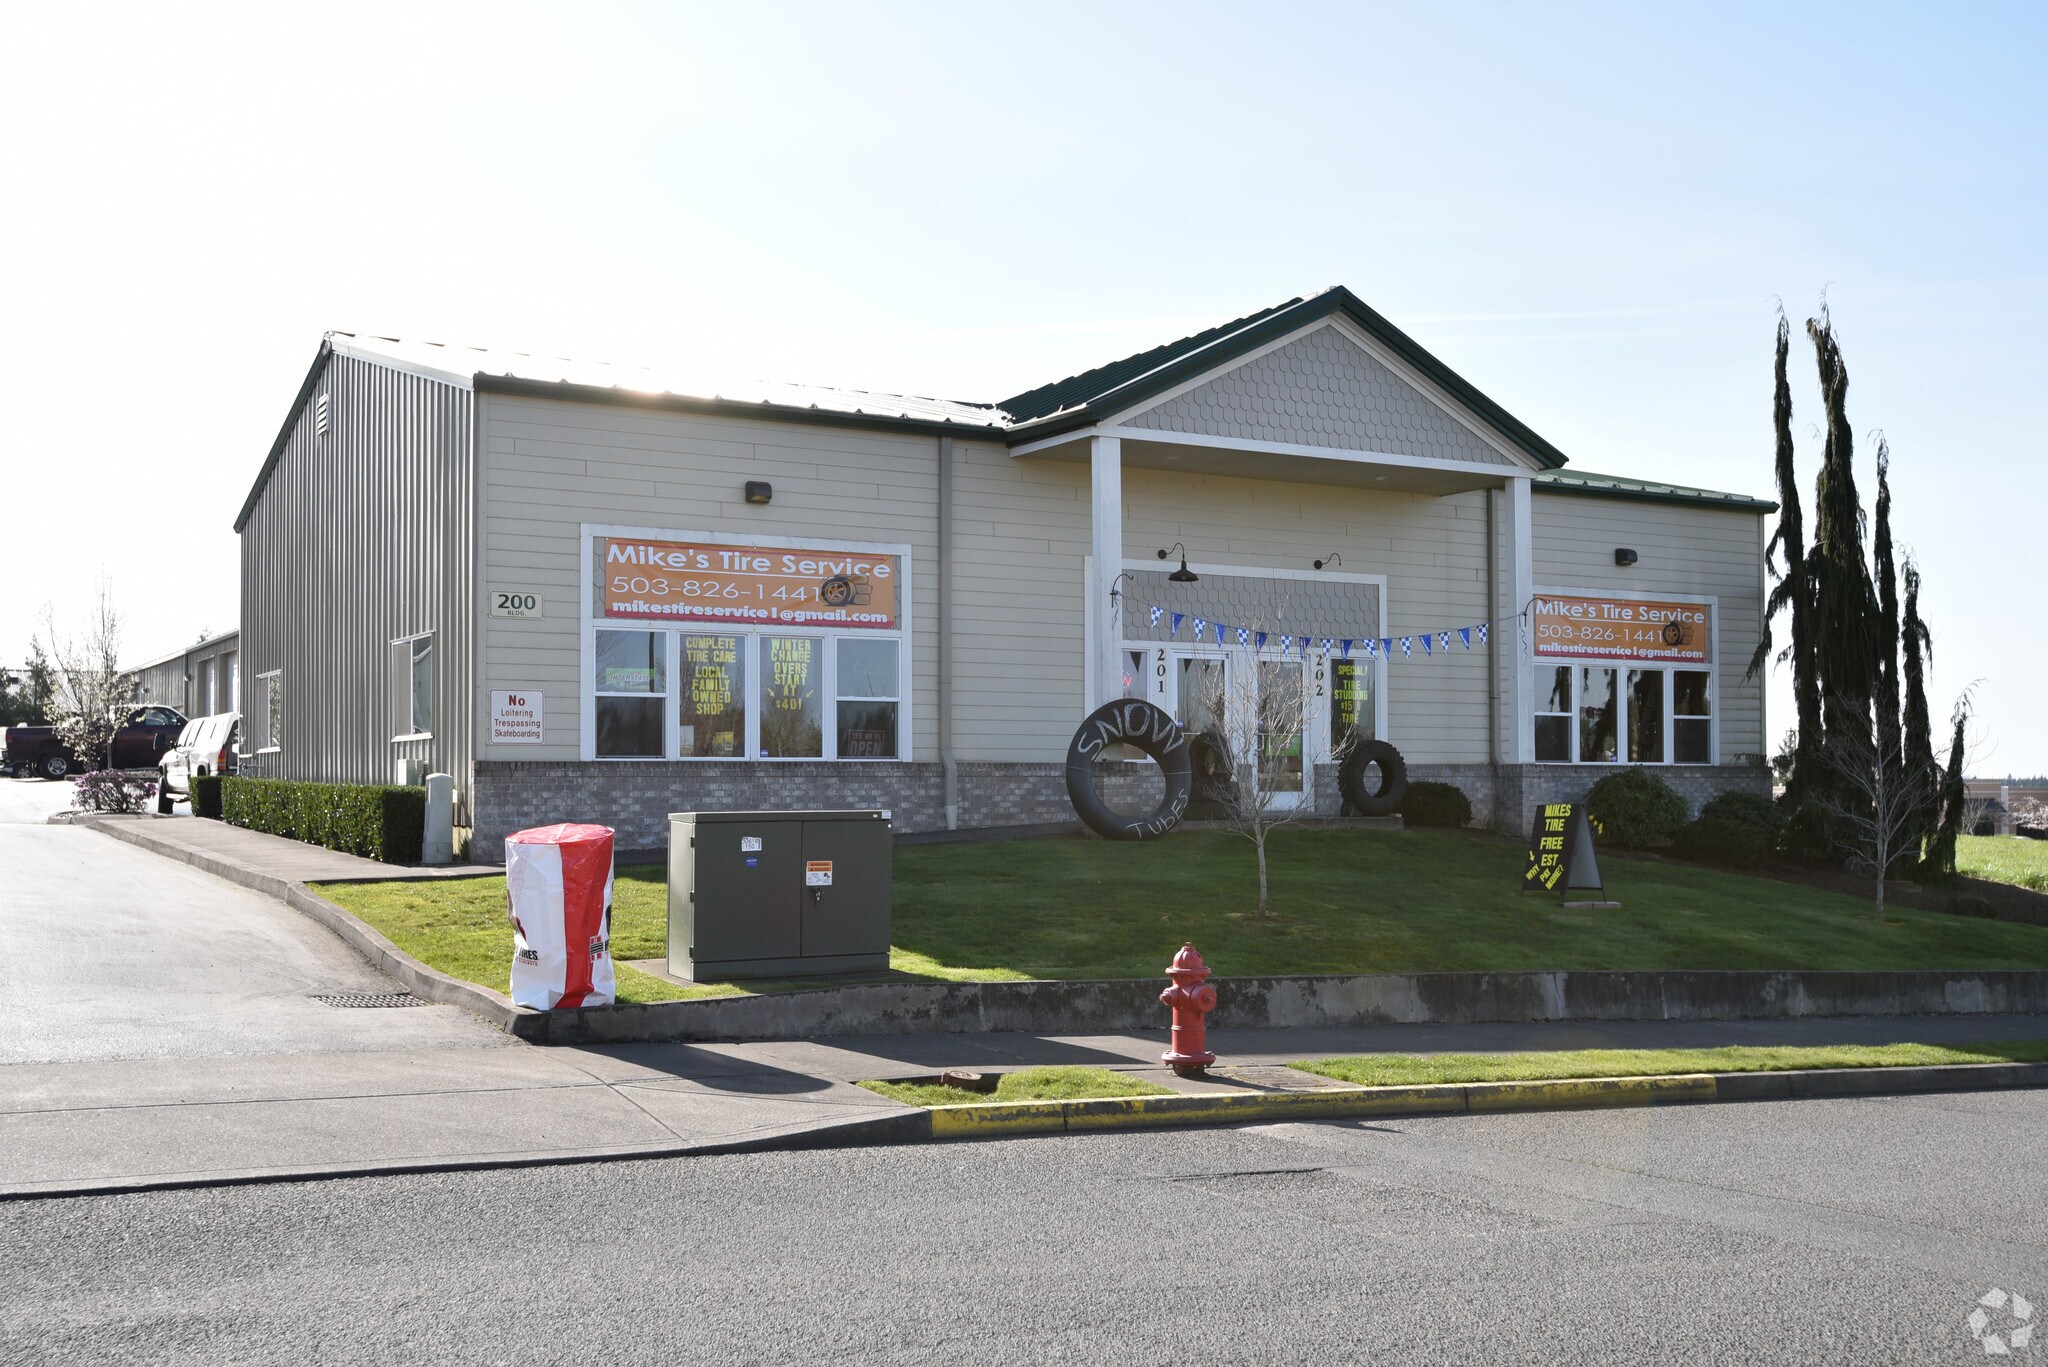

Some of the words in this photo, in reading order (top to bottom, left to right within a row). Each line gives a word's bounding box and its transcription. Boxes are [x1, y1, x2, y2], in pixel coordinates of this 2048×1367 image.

[607, 544, 710, 569] Mike's
[719, 551, 771, 572] Tire
[781, 555, 891, 578] Service
[611, 576, 820, 602] 503-826-1441
[497, 594, 536, 610] 200
[1535, 600, 1597, 618] Mike's
[1602, 604, 1633, 619] Tire
[1639, 606, 1704, 624] Service
[1538, 625, 1663, 643] 503-826-1441
[685, 637, 736, 649] COMPLETE
[771, 638, 811, 650] WINTER
[686, 650, 709, 662] TIRE
[713, 651, 736, 663] CARE
[771, 650, 811, 662] CHANGE
[695, 666, 729, 678] LOCAL
[774, 662, 808, 674] OVERS
[1156, 648, 1166, 693] 201
[774, 674, 807, 686] START
[1315, 654, 1324, 697] 202
[692, 679, 730, 691] FAMILY
[783, 685, 796, 697] AT
[1342, 680, 1361, 690] TIRE
[508, 694, 526, 706] No
[693, 691, 731, 703] OWNED
[1334, 689, 1368, 700] STUDDING
[500, 708, 534, 718] Loitering
[696, 703, 724, 715] SHOP
[494, 718, 541, 730] Trespassing
[1341, 713, 1359, 724] TIRE
[494, 728, 541, 739] Skateboarding
[1077, 703, 1185, 762] SNOW
[1544, 803, 1572, 817] MIKES
[1545, 818, 1565, 831] TIRE
[1540, 837, 1564, 850] FREE
[1540, 853, 1559, 866] EST
[1525, 863, 1540, 880] WHY
[1539, 867, 1551, 882] PAY
